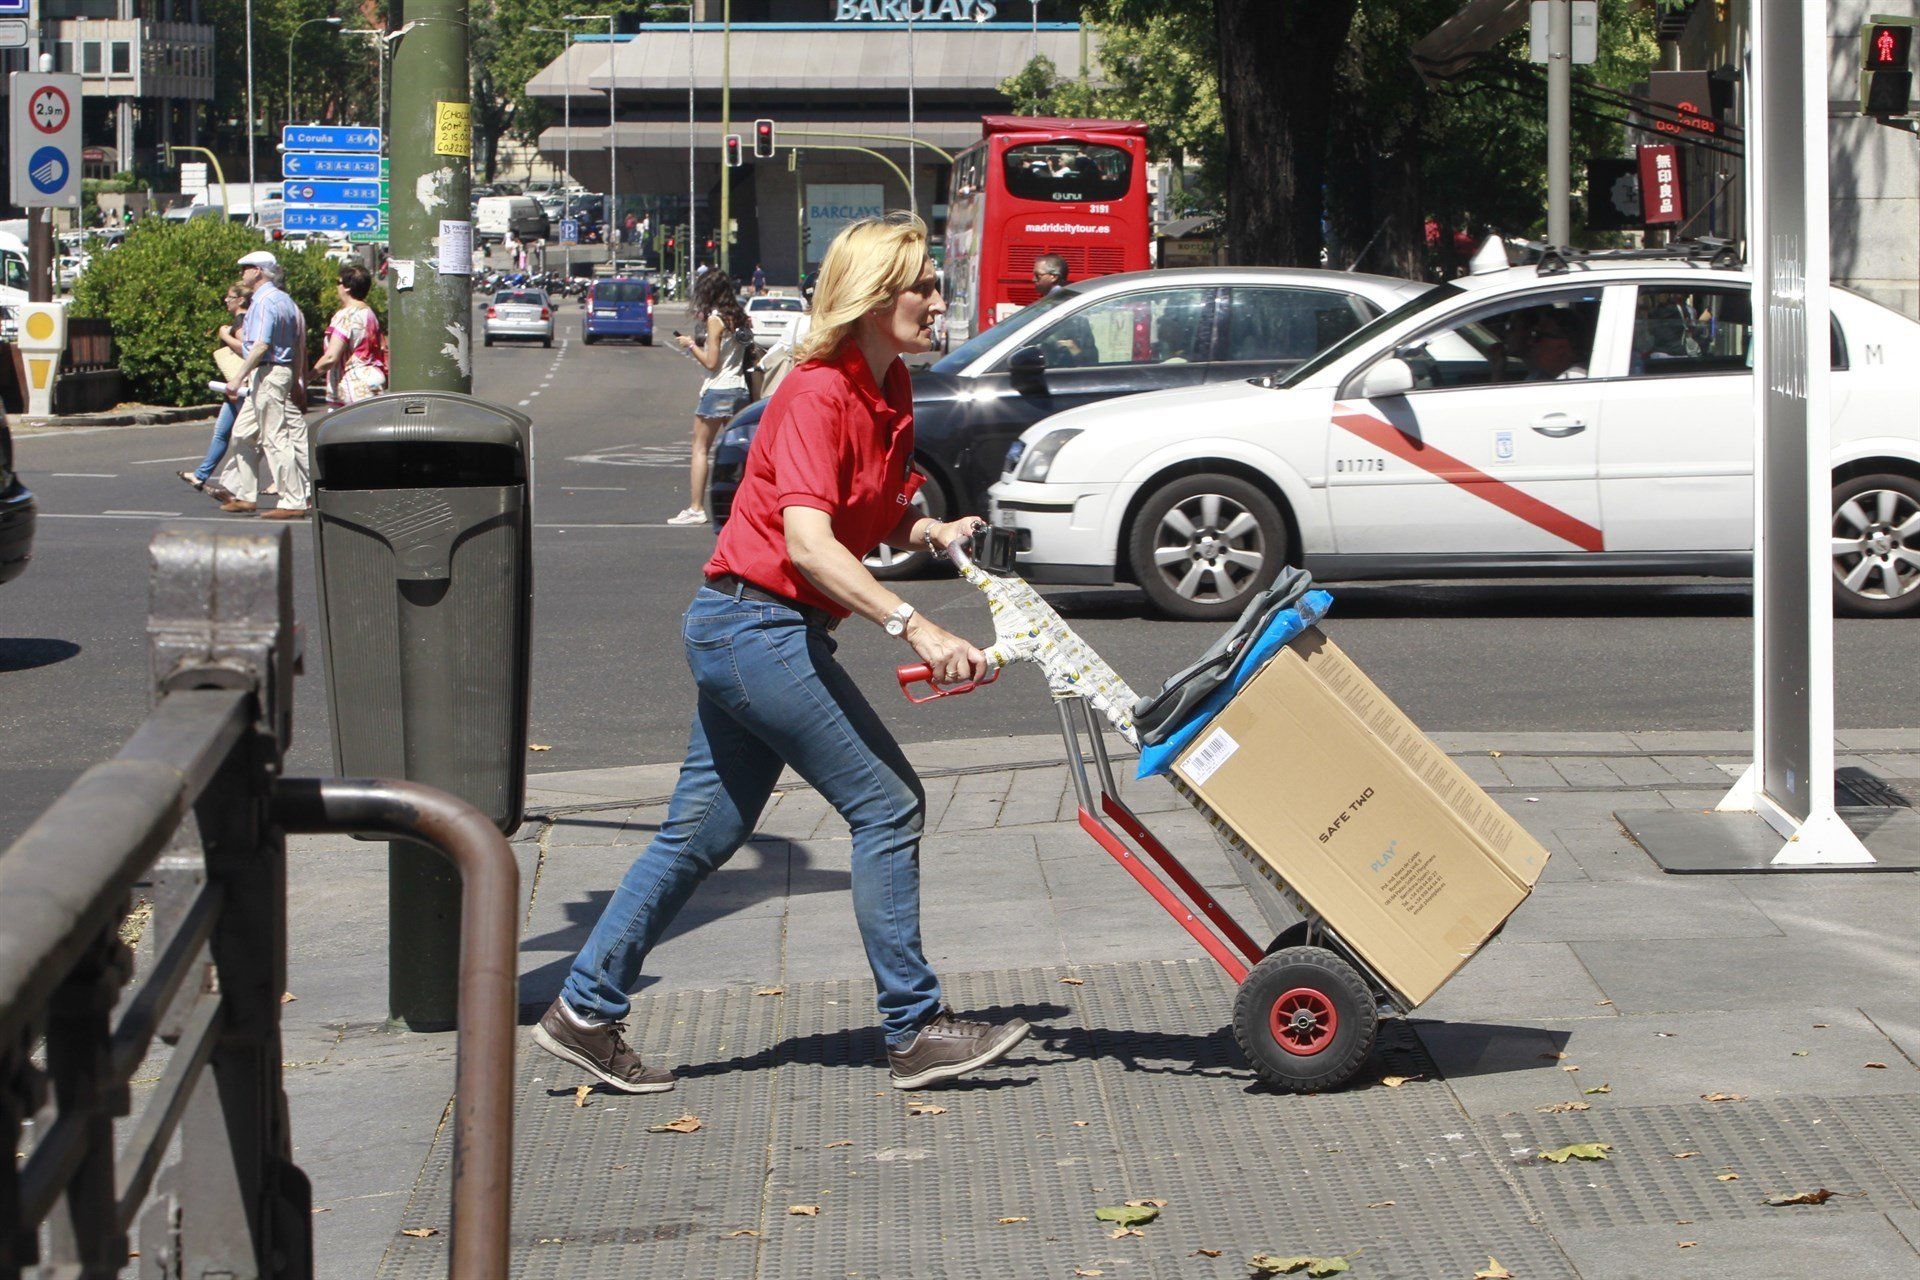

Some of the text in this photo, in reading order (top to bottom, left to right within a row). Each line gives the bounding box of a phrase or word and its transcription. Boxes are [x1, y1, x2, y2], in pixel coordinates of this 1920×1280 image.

[835, 0, 997, 22] BARCLAYS
[287, 134, 294, 142] A
[298, 133, 334, 142] Coruña
[336, 162, 350, 170] A-4
[1656, 154, 1673, 214] 無印良品
[810, 206, 881, 218] BARCLAYS
[1090, 204, 1109, 214] 3191
[1025, 223, 1110, 235] madridcitytour.es
[1866, 344, 1884, 364] M
[1336, 458, 1384, 472] 01779
[1318, 786, 1375, 844] SAFE TWO
